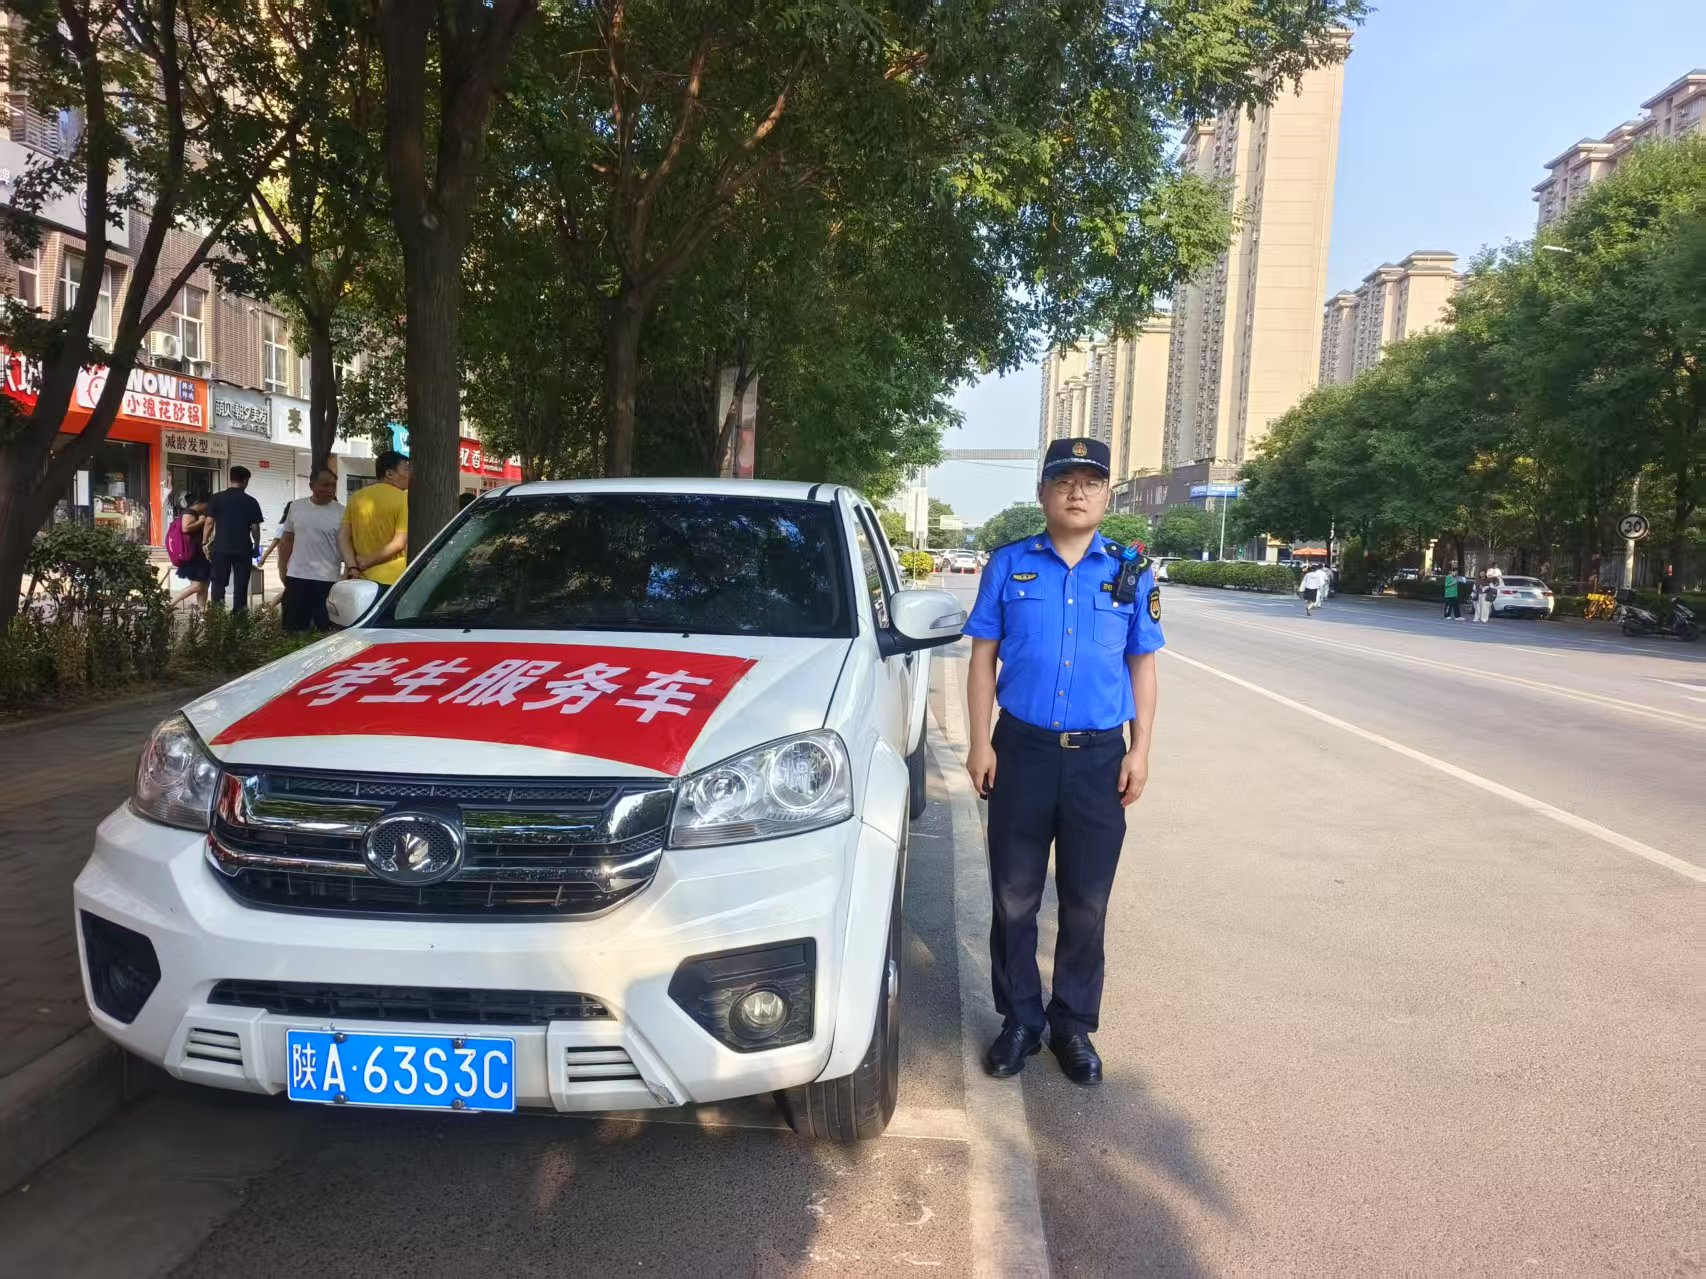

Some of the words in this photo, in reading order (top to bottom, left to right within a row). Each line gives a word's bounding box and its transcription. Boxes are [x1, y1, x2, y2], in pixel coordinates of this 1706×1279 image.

[127, 394, 200, 425] 小浪花砂锅
[165, 434, 209, 454] 减龄发型
[1624, 520, 1642, 533] 30
[298, 656, 714, 724] 考生服务车
